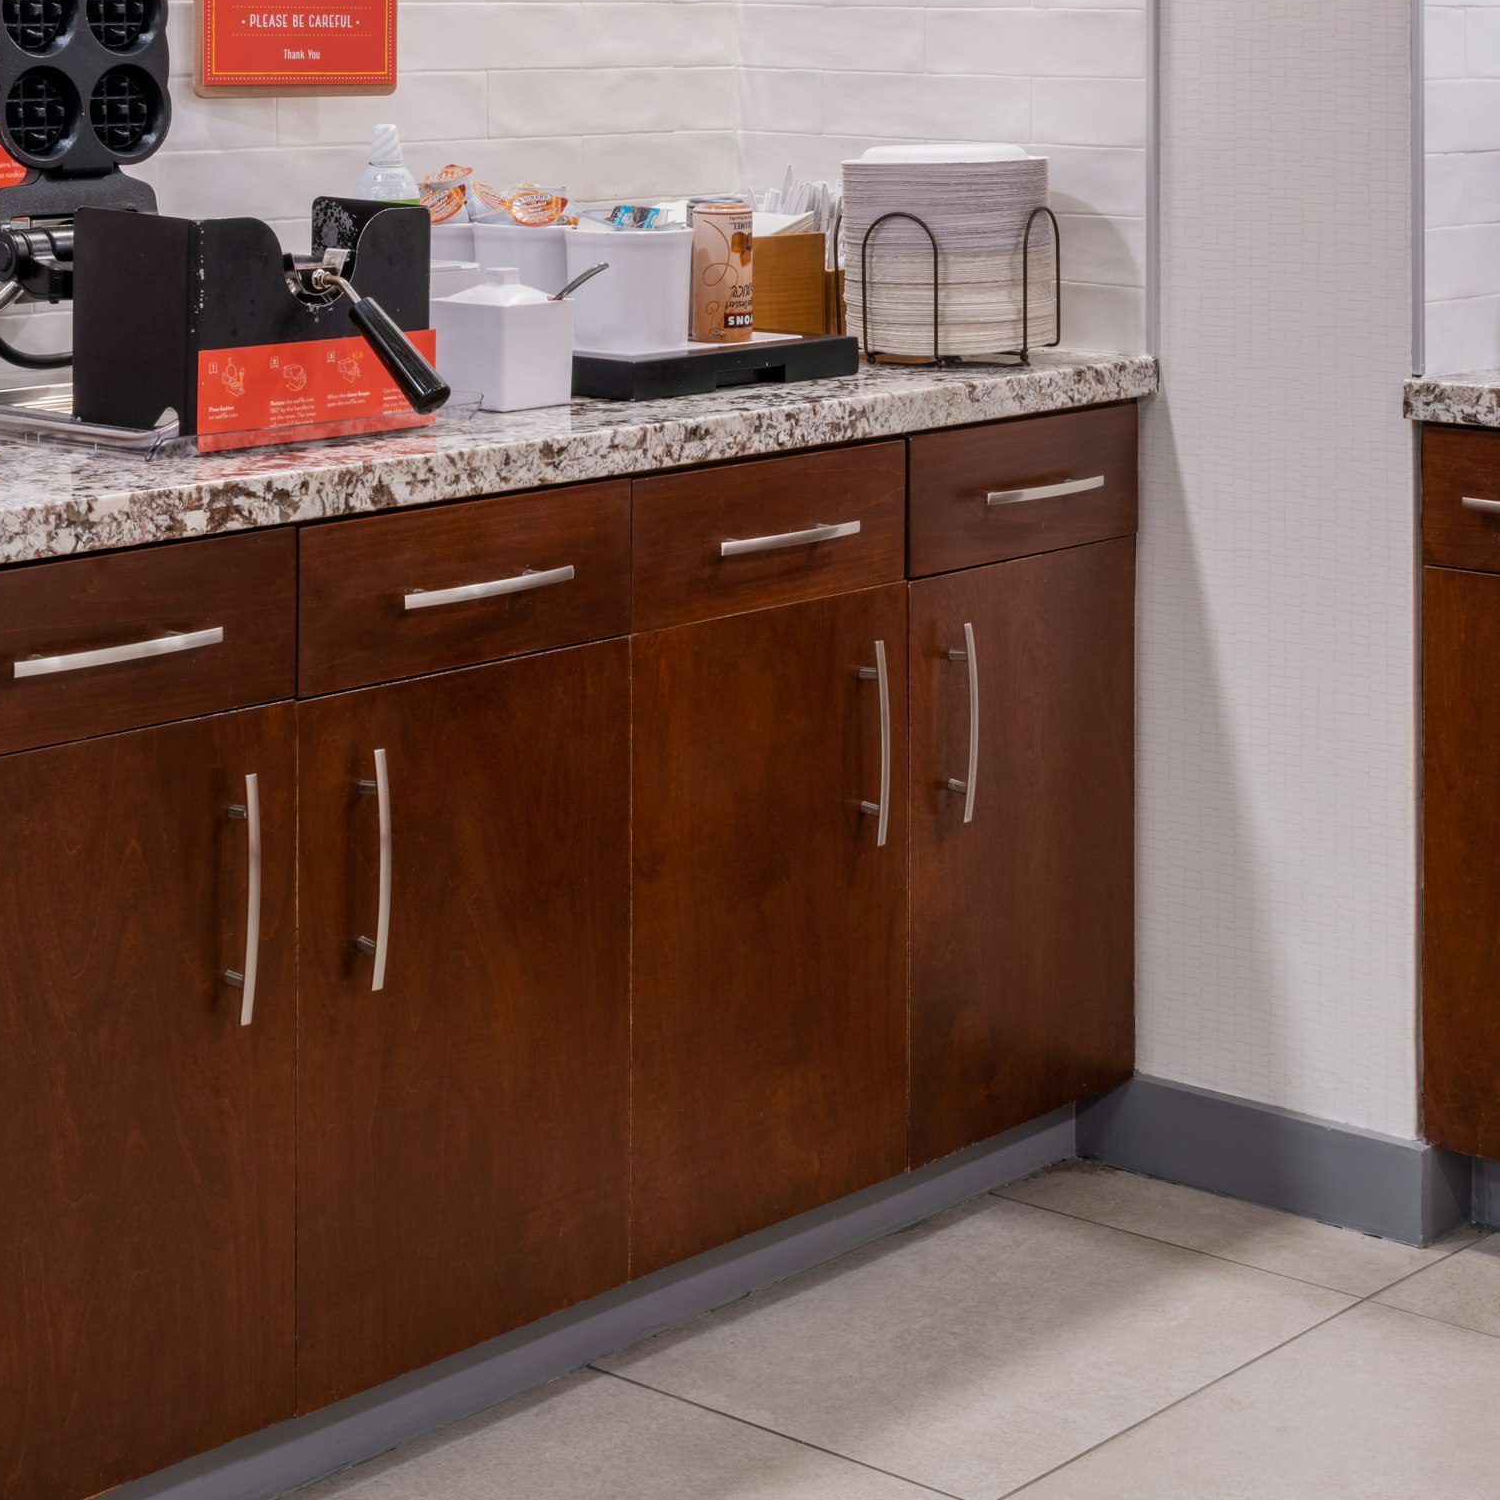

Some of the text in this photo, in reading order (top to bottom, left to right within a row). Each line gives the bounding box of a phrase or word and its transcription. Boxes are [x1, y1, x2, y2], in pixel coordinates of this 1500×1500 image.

[249, 14, 352, 28] PLEASE BE CAREFUL
[283, 49, 320, 60] Thank You
[6, 170, 26, 178] cookin
[728, 314, 753, 326] ONS
